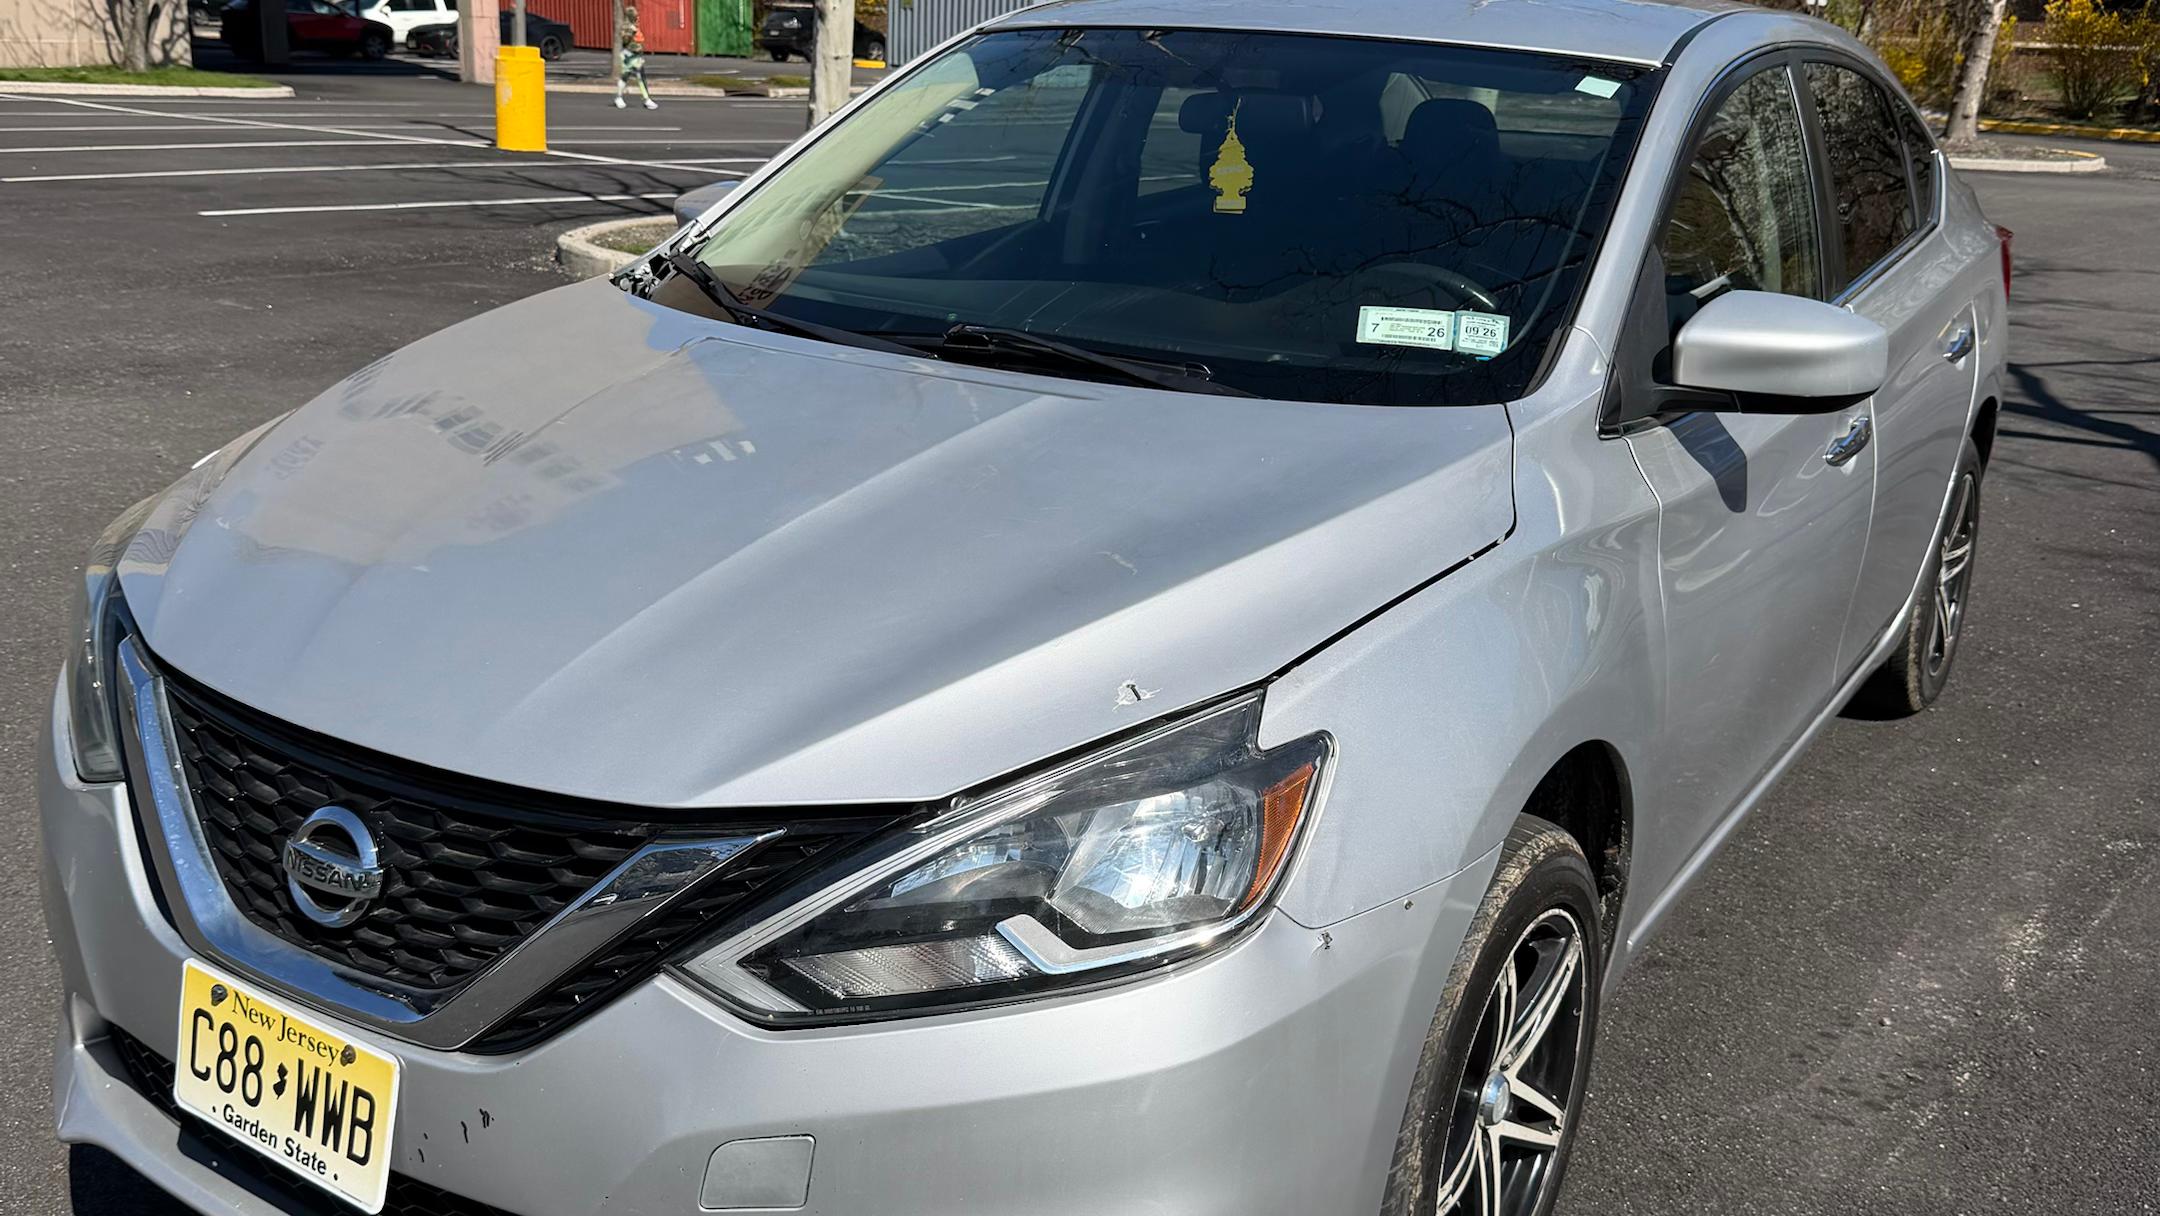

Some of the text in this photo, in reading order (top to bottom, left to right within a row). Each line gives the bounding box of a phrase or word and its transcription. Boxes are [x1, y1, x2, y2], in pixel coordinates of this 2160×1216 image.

[1371, 323, 1380, 333] 7
[1427, 326, 1445, 338] 26
[1465, 325, 1497, 338] 09 26
[288, 848, 364, 891] NISSAN
[232, 990, 340, 1066] New Jersey
[190, 1008, 376, 1167] C88 WWB
[223, 1103, 328, 1175] Garden State
